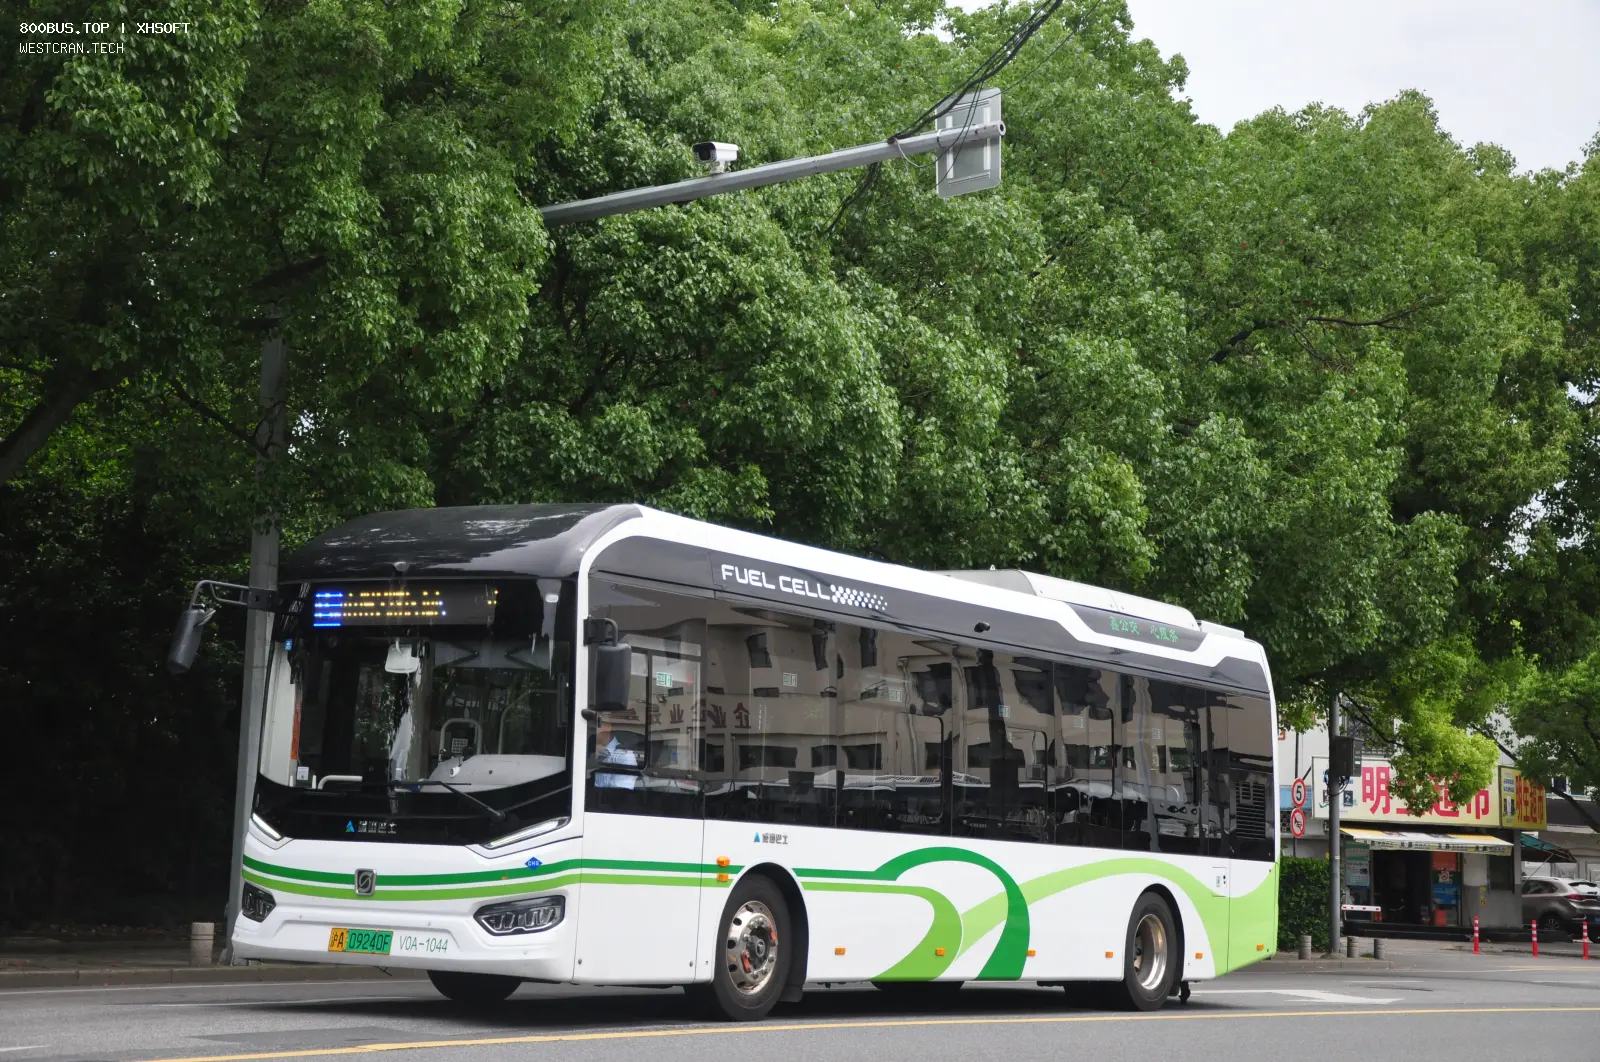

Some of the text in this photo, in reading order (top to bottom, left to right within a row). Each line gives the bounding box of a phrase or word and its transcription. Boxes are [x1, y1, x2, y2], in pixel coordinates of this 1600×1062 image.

[721, 563, 831, 601] FUEL CELL
[1296, 785, 1303, 802] 5
